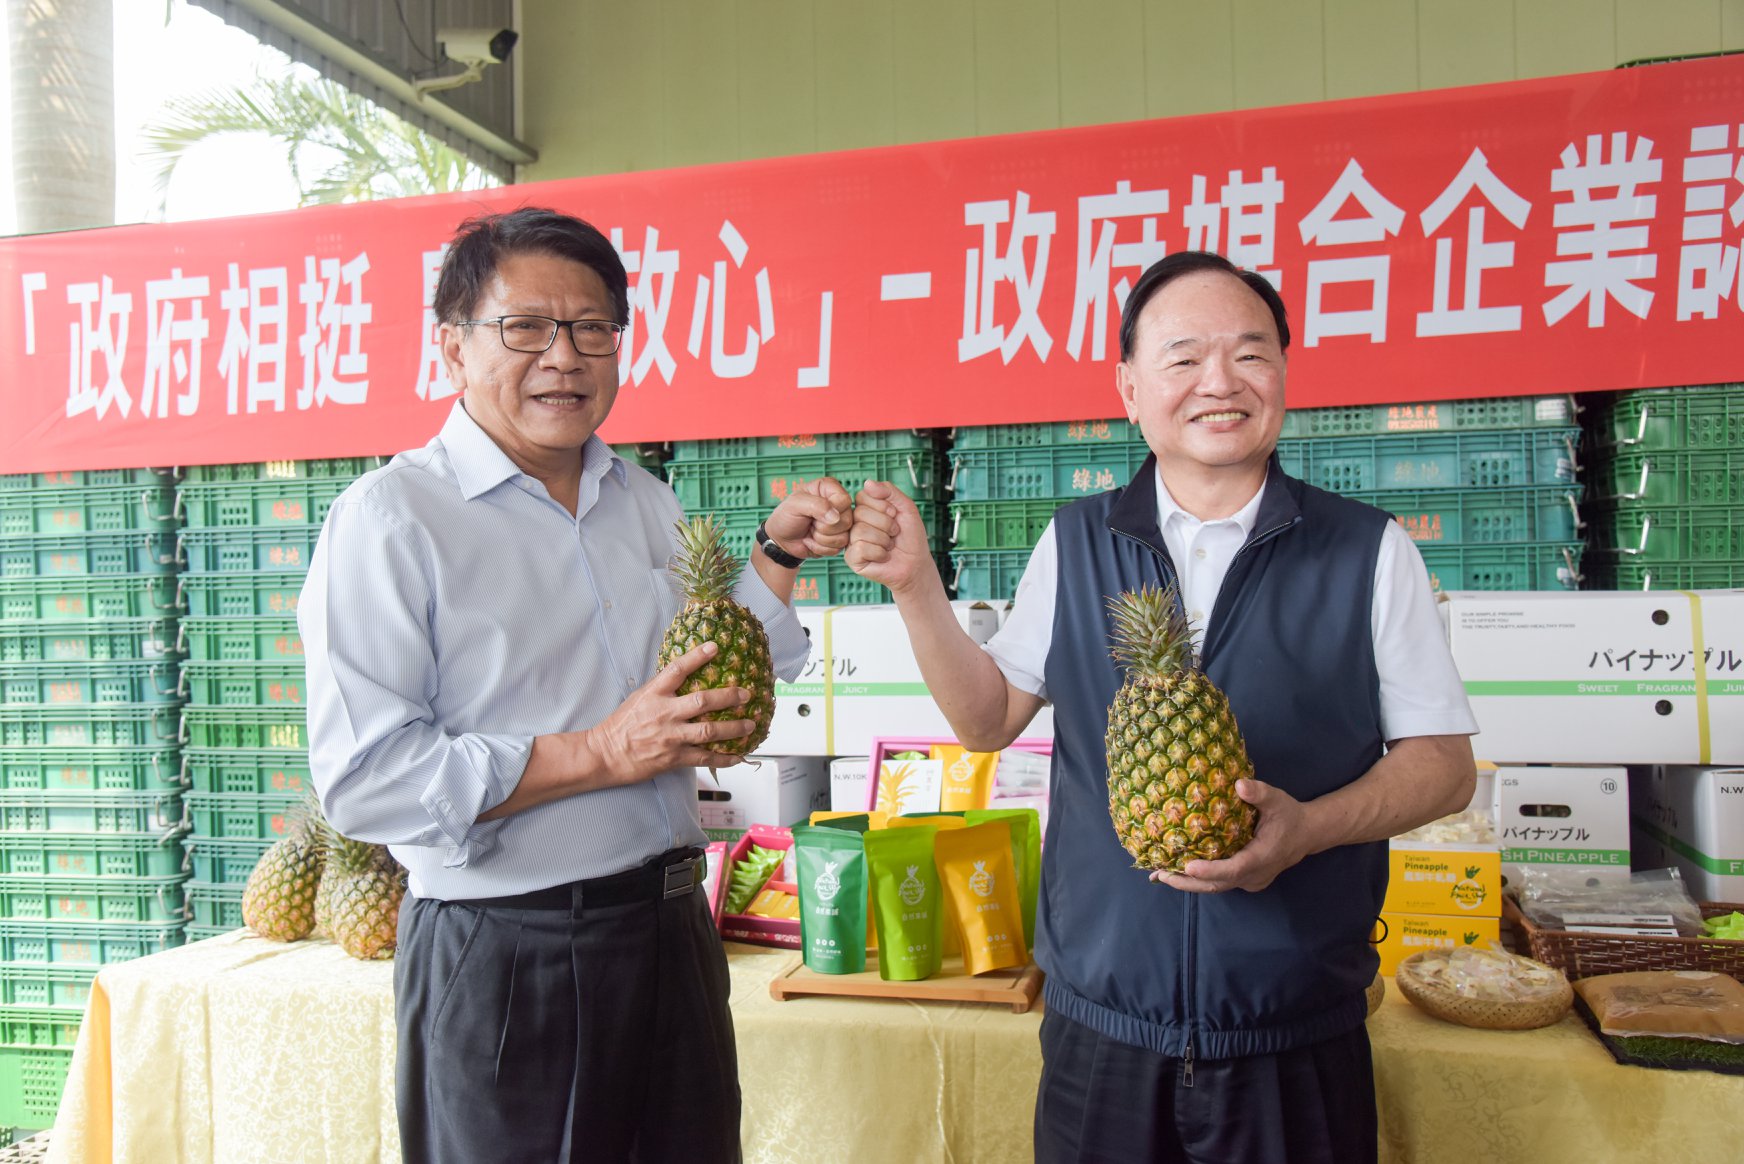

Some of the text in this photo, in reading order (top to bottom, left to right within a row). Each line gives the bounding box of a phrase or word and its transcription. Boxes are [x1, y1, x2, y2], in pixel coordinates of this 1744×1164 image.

[22, 251, 373, 421] 「政府相挺
[1072, 468, 1116, 492] 綠地
[1589, 647, 1743, 671] パイナップル
[781, 686, 825, 694] FRAGRAN
[1577, 683, 1619, 693] SWEET
[1637, 683, 1697, 693] FRAGRAN
[1527, 851, 1620, 864] PINEAPPLE
[1405, 862, 1449, 871] Pineapple
[1403, 926, 1448, 936] Pineapple
